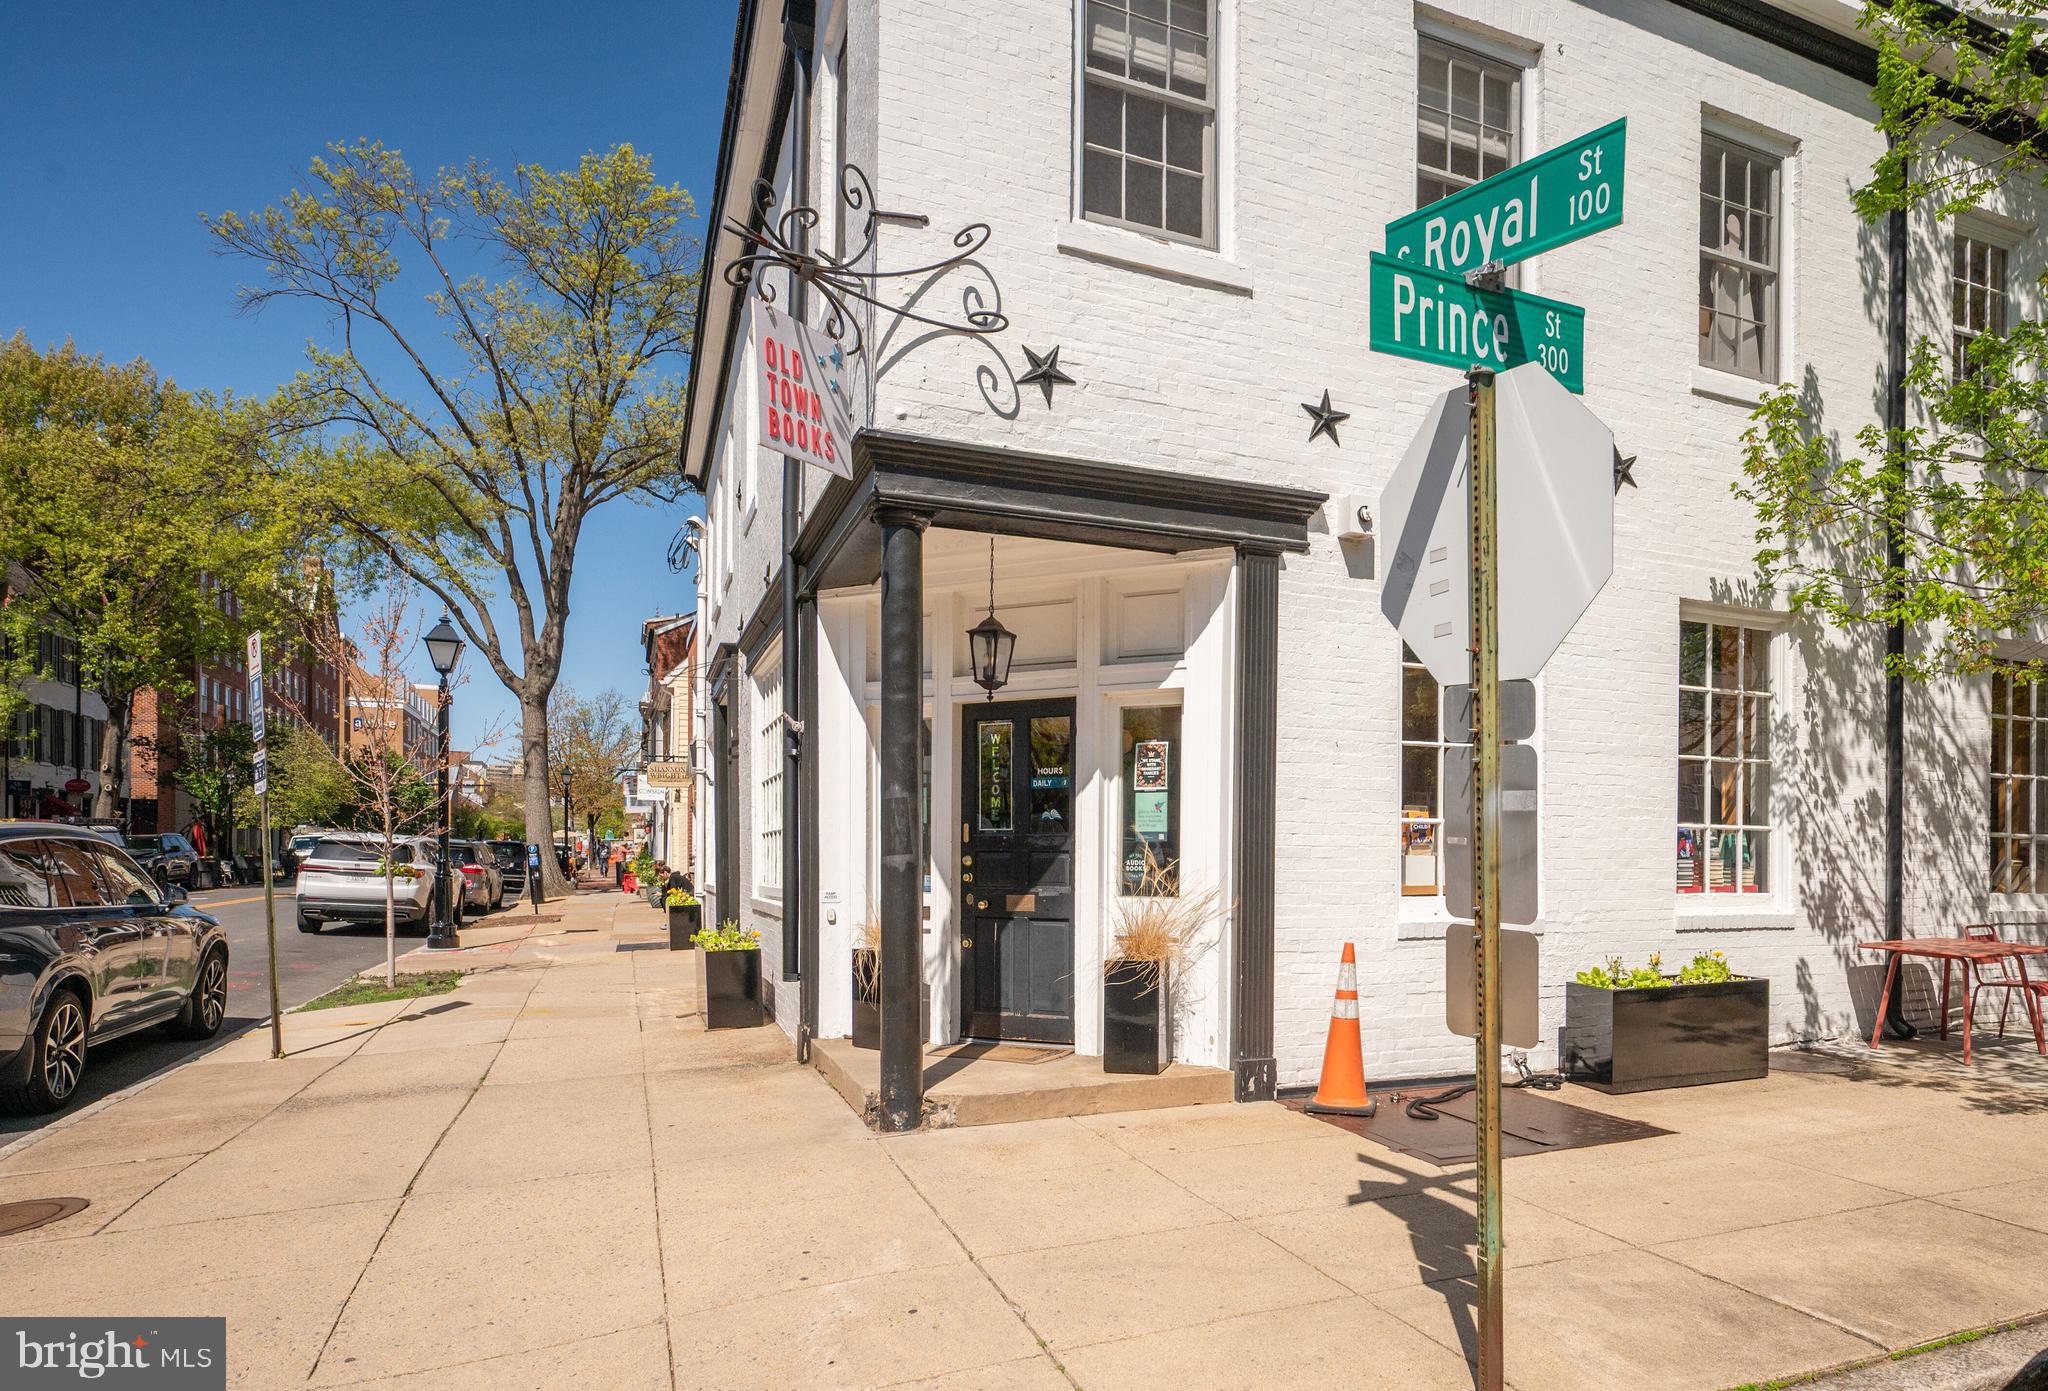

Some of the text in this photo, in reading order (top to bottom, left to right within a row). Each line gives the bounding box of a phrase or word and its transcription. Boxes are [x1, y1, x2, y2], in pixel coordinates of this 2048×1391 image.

[1424, 145, 1603, 271] Royal St
[1569, 182, 1610, 226] 100
[1394, 274, 1509, 363] Prince
[1545, 310, 1561, 340] St
[764, 336, 803, 380] OLD
[1537, 343, 1568, 374] 300
[767, 371, 821, 423] TOWN
[768, 406, 833, 462] BOOKS
[991, 734, 1001, 822] WELCOME
[1033, 779, 1053, 787] DAILY
[1037, 767, 1064, 775] HOURS
